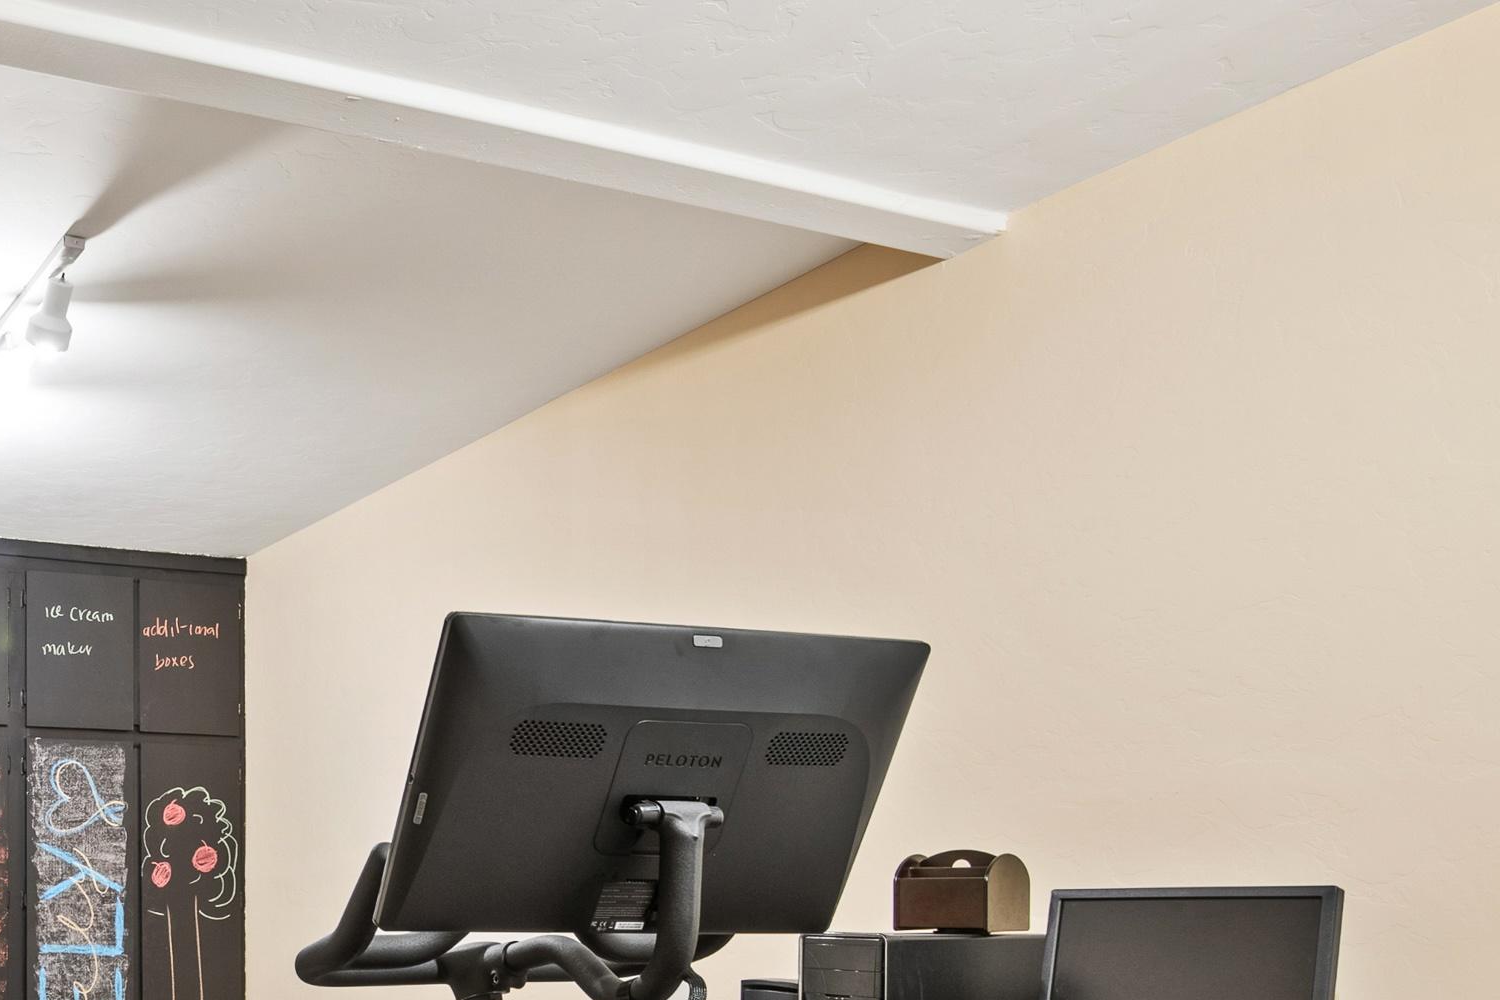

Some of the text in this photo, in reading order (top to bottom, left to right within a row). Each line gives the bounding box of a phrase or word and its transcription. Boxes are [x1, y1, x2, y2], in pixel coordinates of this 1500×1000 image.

[41, 641, 93, 656] maker
[154, 653, 195, 671] boxes
[644, 753, 723, 768] PELOTON
